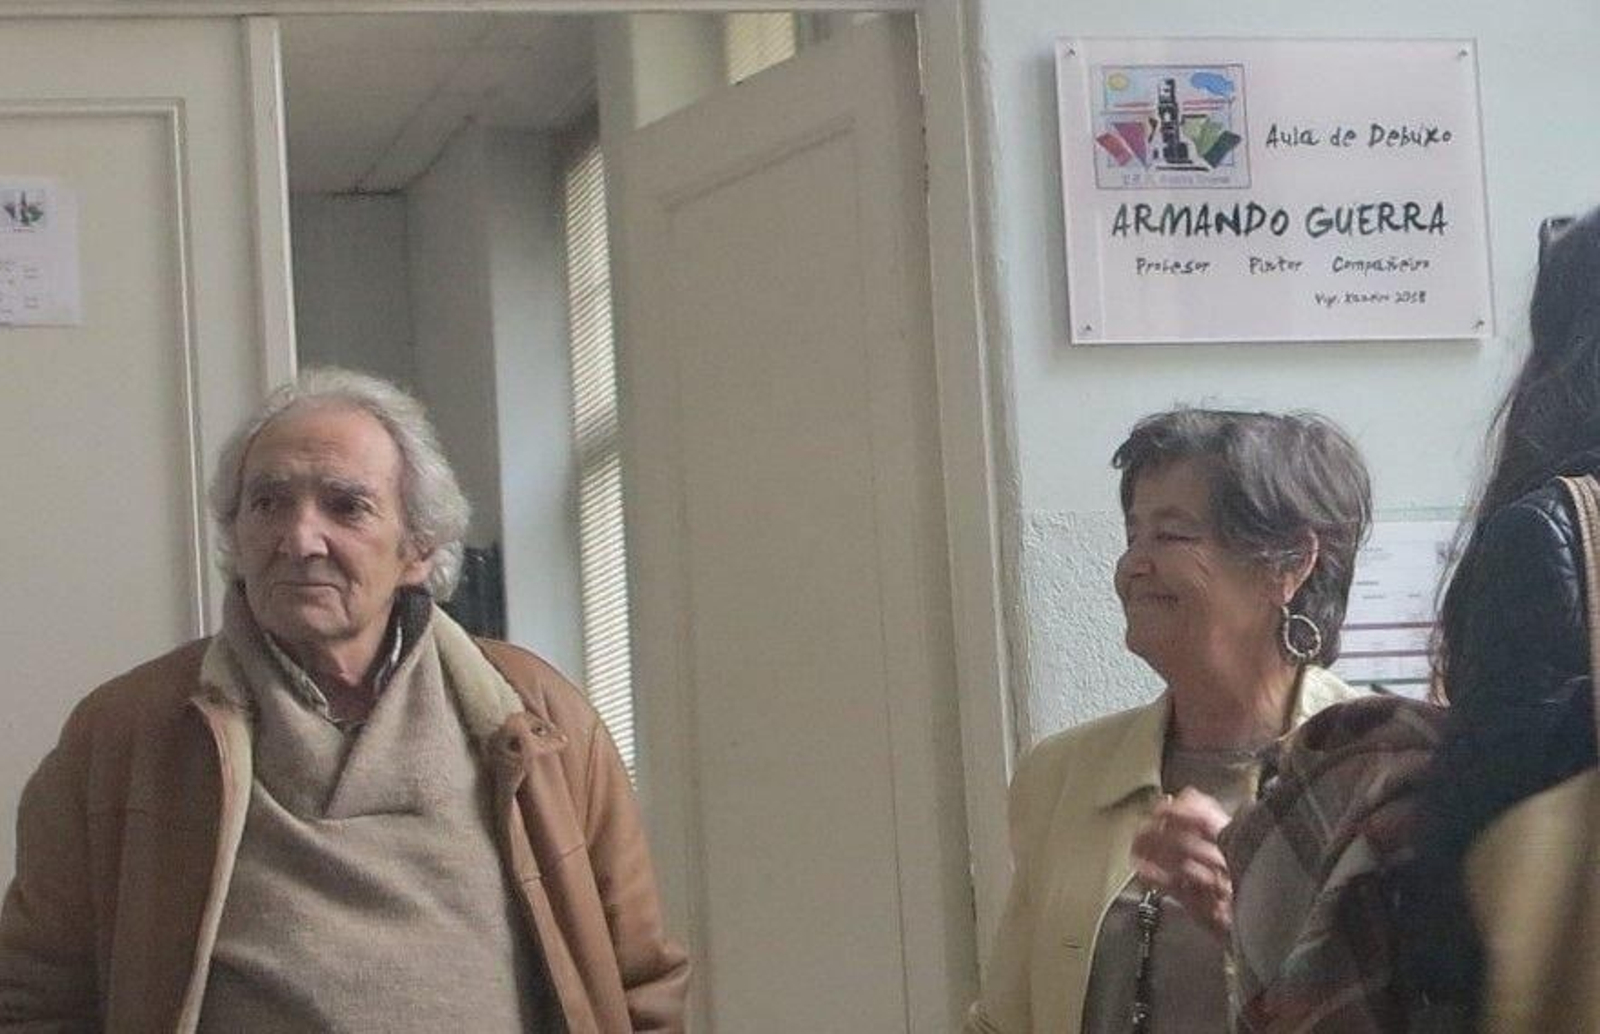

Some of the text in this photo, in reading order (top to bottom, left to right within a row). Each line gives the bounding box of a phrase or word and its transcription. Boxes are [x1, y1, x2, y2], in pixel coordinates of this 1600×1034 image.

[1266, 124, 1452, 148] Aula de Debuxo
[1111, 201, 1448, 238] ARMANDO GUERRA
[1136, 255, 1430, 277] Profesor Pintor Compañeiro
